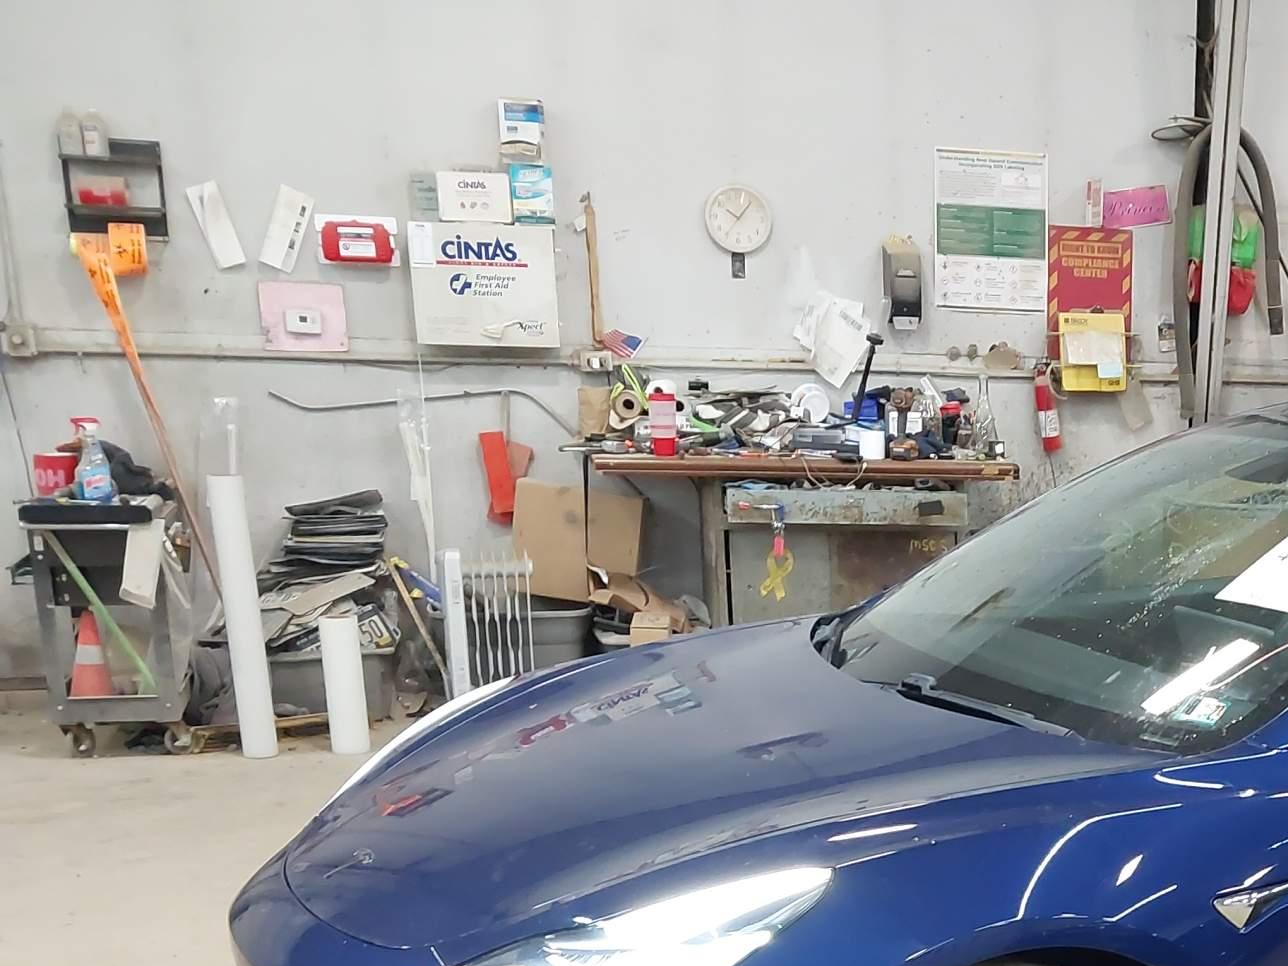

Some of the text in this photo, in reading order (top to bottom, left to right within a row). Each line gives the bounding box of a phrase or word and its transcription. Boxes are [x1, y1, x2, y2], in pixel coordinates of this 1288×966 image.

[1061, 256, 1119, 269] COMPLIANCE
[475, 273, 517, 284] Employee
[473, 280, 509, 290] First Aid
[472, 289, 503, 297] Station
